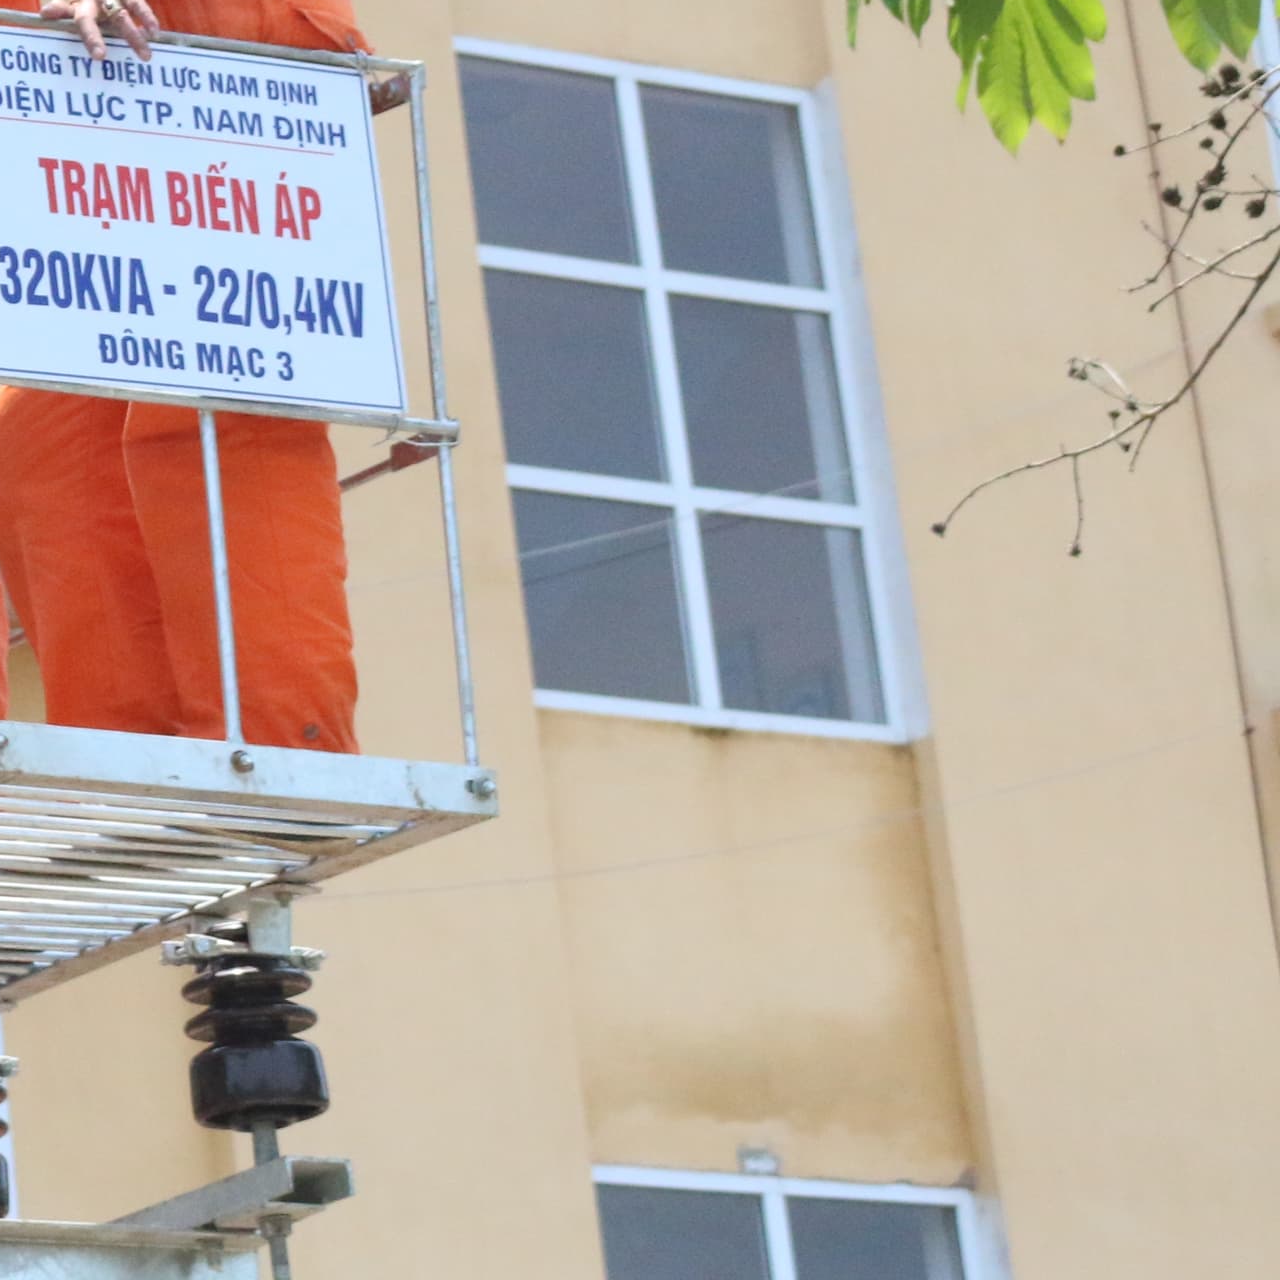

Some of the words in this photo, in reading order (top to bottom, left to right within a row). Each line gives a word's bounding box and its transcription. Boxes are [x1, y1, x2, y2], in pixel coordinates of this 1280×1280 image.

[0, 45, 63, 76] CÔNG
[68, 55, 93, 79] TY
[102, 57, 154, 89] ĐIỆN
[160, 66, 202, 94] LỰC
[208, 71, 260, 99] NAM
[266, 79, 319, 107] ĐỊNH
[65, 91, 127, 125] LỰC
[134, 98, 182, 129] TP.
[192, 105, 264, 138] NAM
[273, 115, 347, 149] ĐỊNH
[37, 157, 155, 230] TRẠM
[165, 161, 261, 235] BIẾN
[274, 171, 322, 241] ÁP
[162, 283, 177, 296] -
[193, 264, 364, 339] 22/0,4KV
[98, 328, 186, 371] ĐÔNG
[195, 342, 267, 383] MẠC
[275, 350, 295, 382] 3
